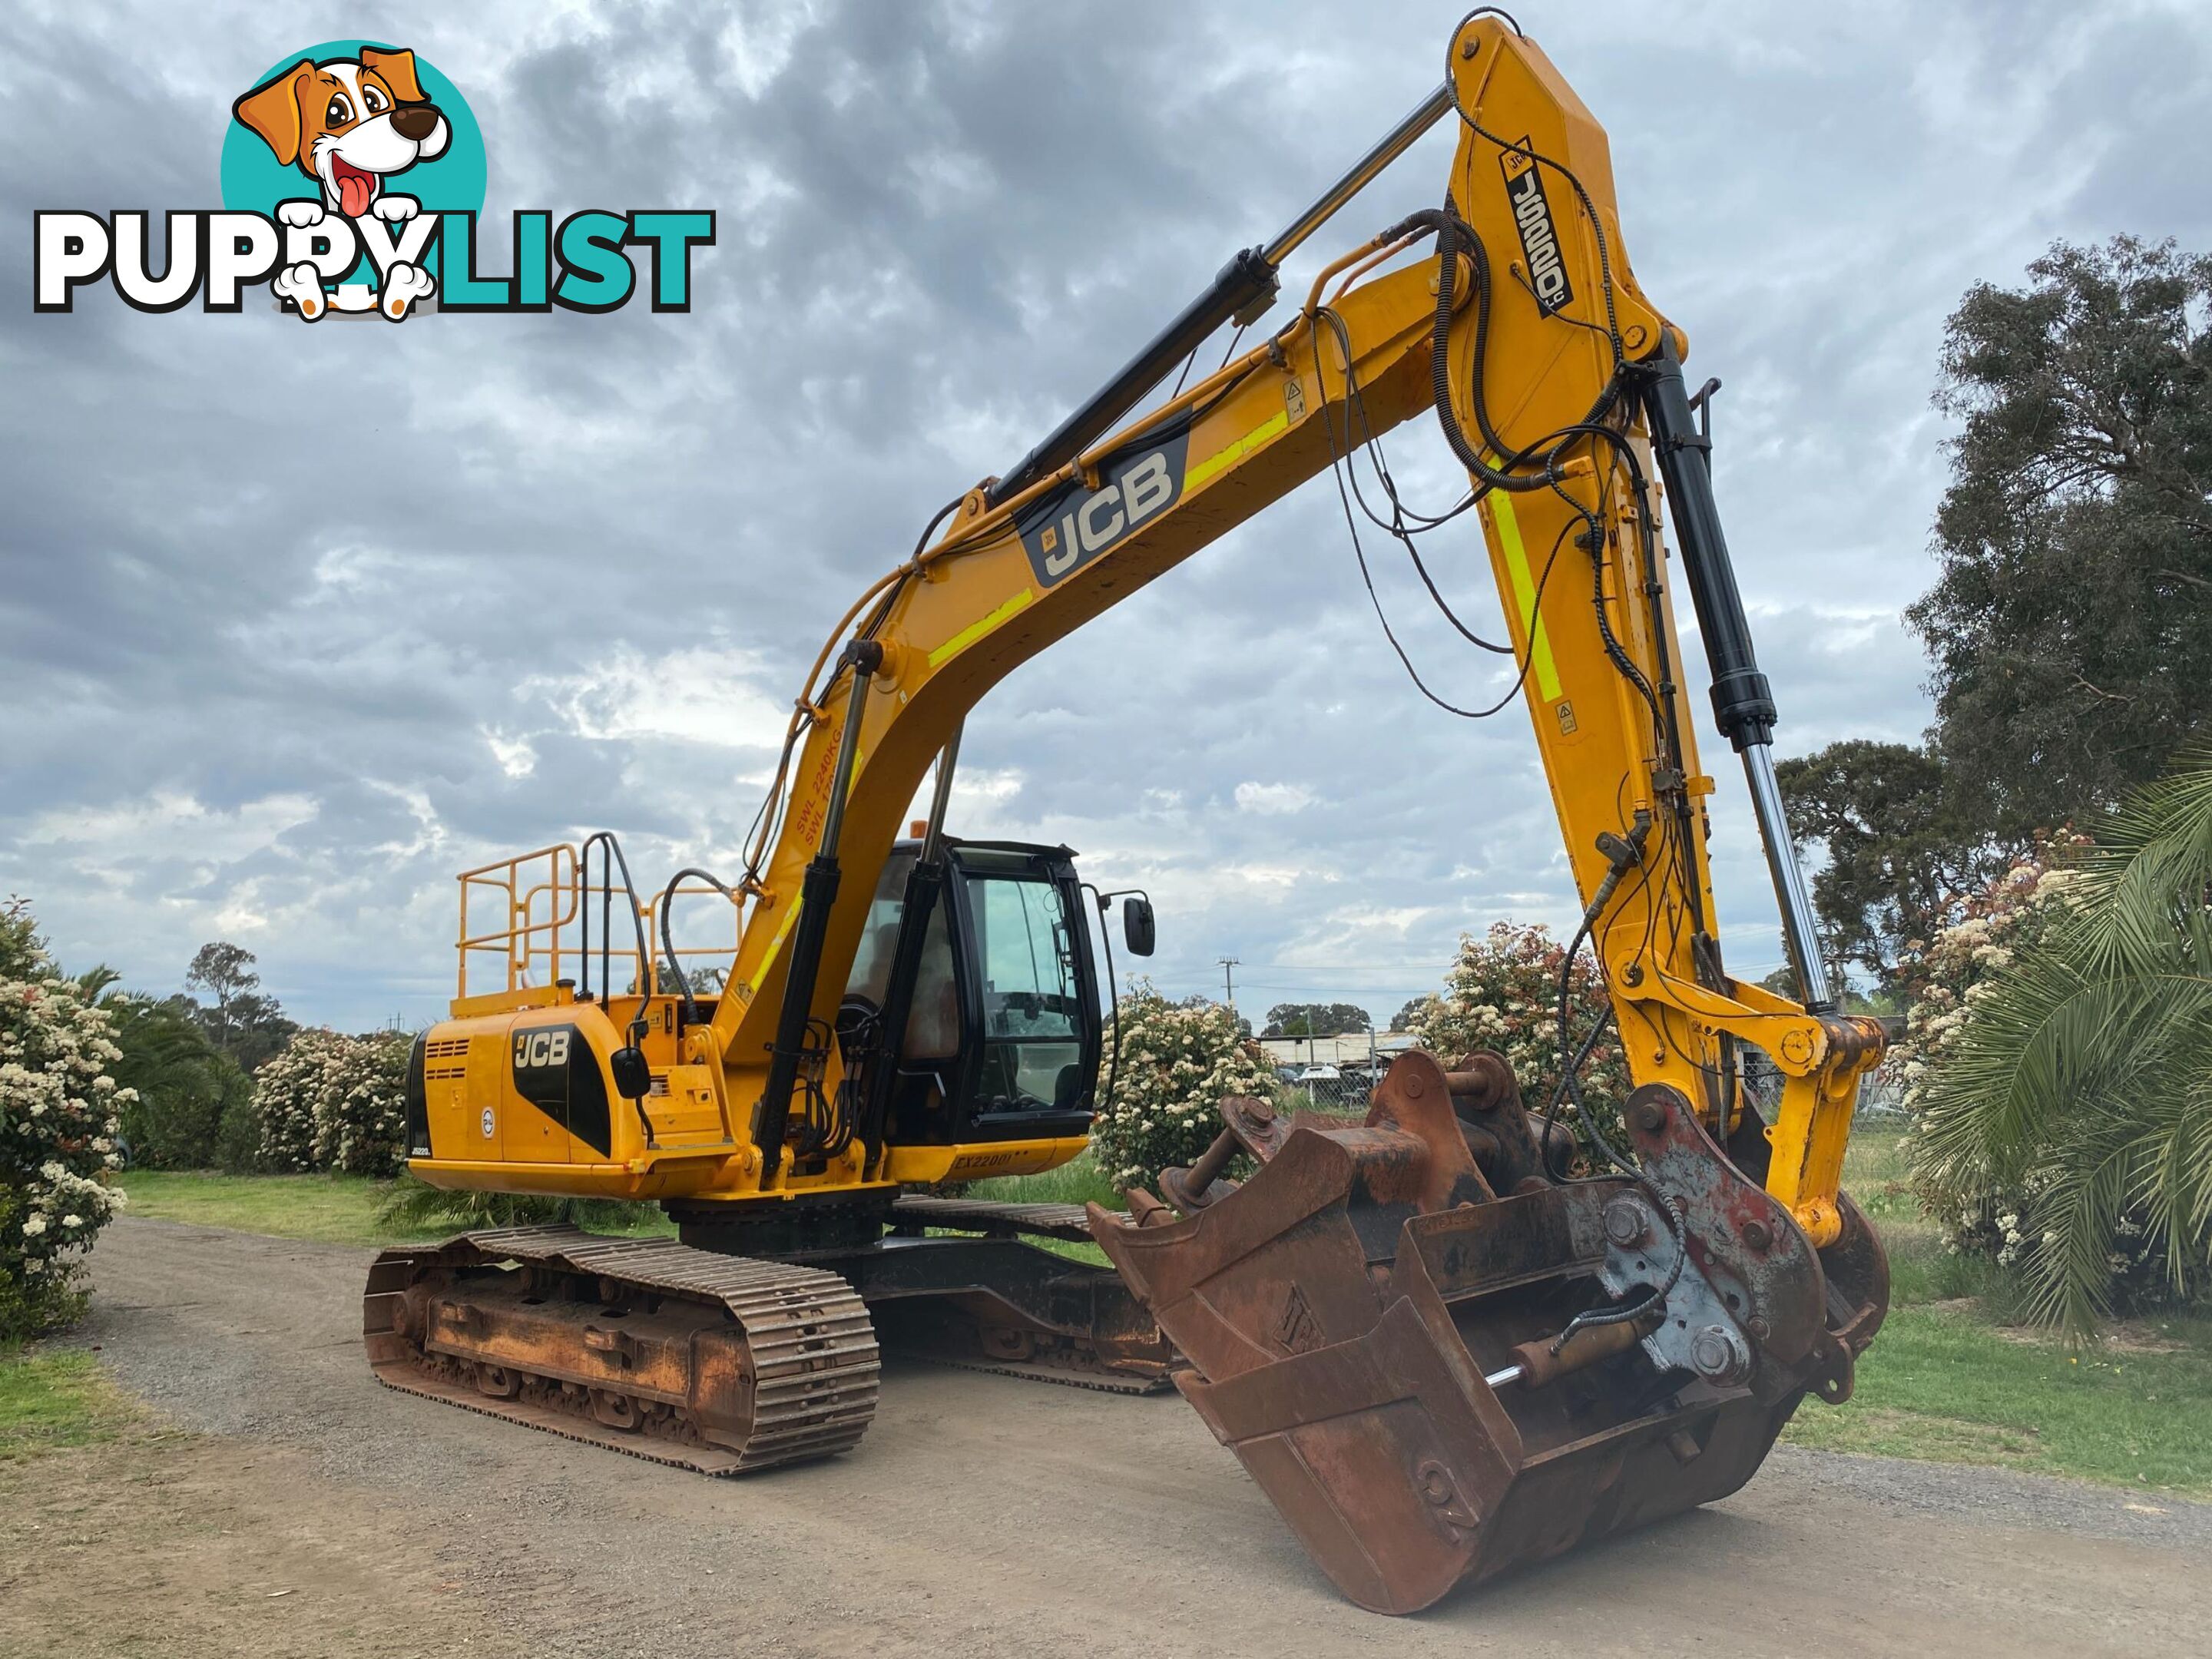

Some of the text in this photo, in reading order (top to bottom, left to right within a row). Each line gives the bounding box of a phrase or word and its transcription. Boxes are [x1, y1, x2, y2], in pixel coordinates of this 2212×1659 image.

[1513, 171, 1565, 299] JS220
[1045, 452, 1173, 576] JCB
[796, 800, 816, 835] SWL
[806, 810, 825, 846] SWL
[515, 1030, 570, 1068] JCB
